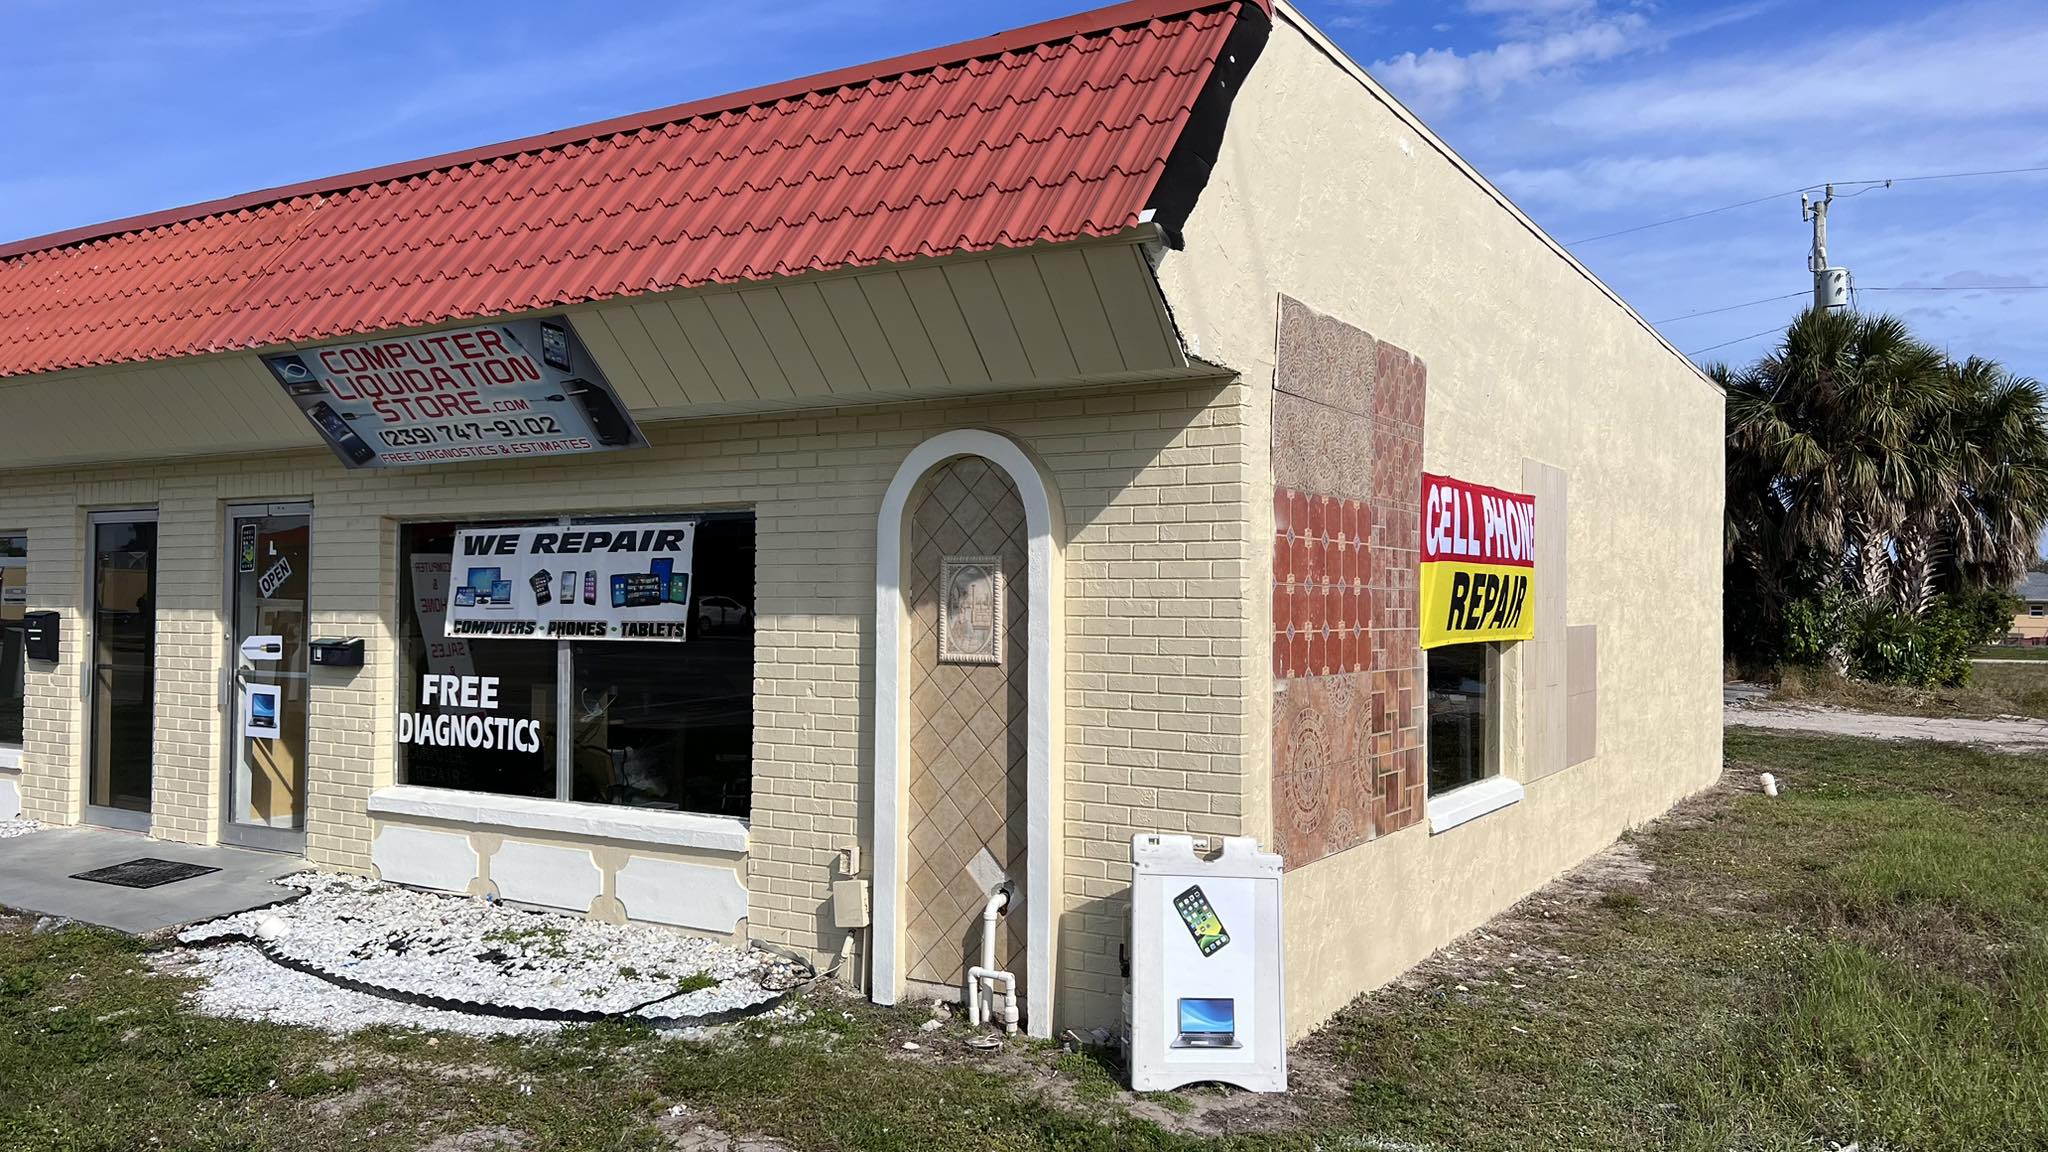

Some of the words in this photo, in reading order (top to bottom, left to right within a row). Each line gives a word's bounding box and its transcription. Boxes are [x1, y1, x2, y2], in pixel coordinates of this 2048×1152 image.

[319, 330, 510, 374] COMPUTER
[325, 356, 541, 400] LIQUIDATION
[378, 427, 438, 447] (239)
[436, 416, 562, 442] 747-9102
[381, 453, 414, 464] FREE
[415, 445, 498, 461] DIAGNOSTICS
[499, 444, 510, 455] &
[510, 438, 591, 454] ESTIMATES
[1425, 484, 1481, 557] CELL
[1480, 494, 1535, 562] PHONE
[269, 540, 277, 556] L
[464, 534, 521, 556] WE
[529, 529, 685, 555] REPAIR
[261, 560, 290, 593] OPEN
[1446, 572, 1528, 631] REPAIR
[453, 619, 537, 636] COMPUTERS
[549, 620, 607, 637] PHONES
[621, 622, 686, 638] TABLETS
[422, 674, 500, 709] FREE
[398, 712, 541, 753] DIAGNOSTICS
